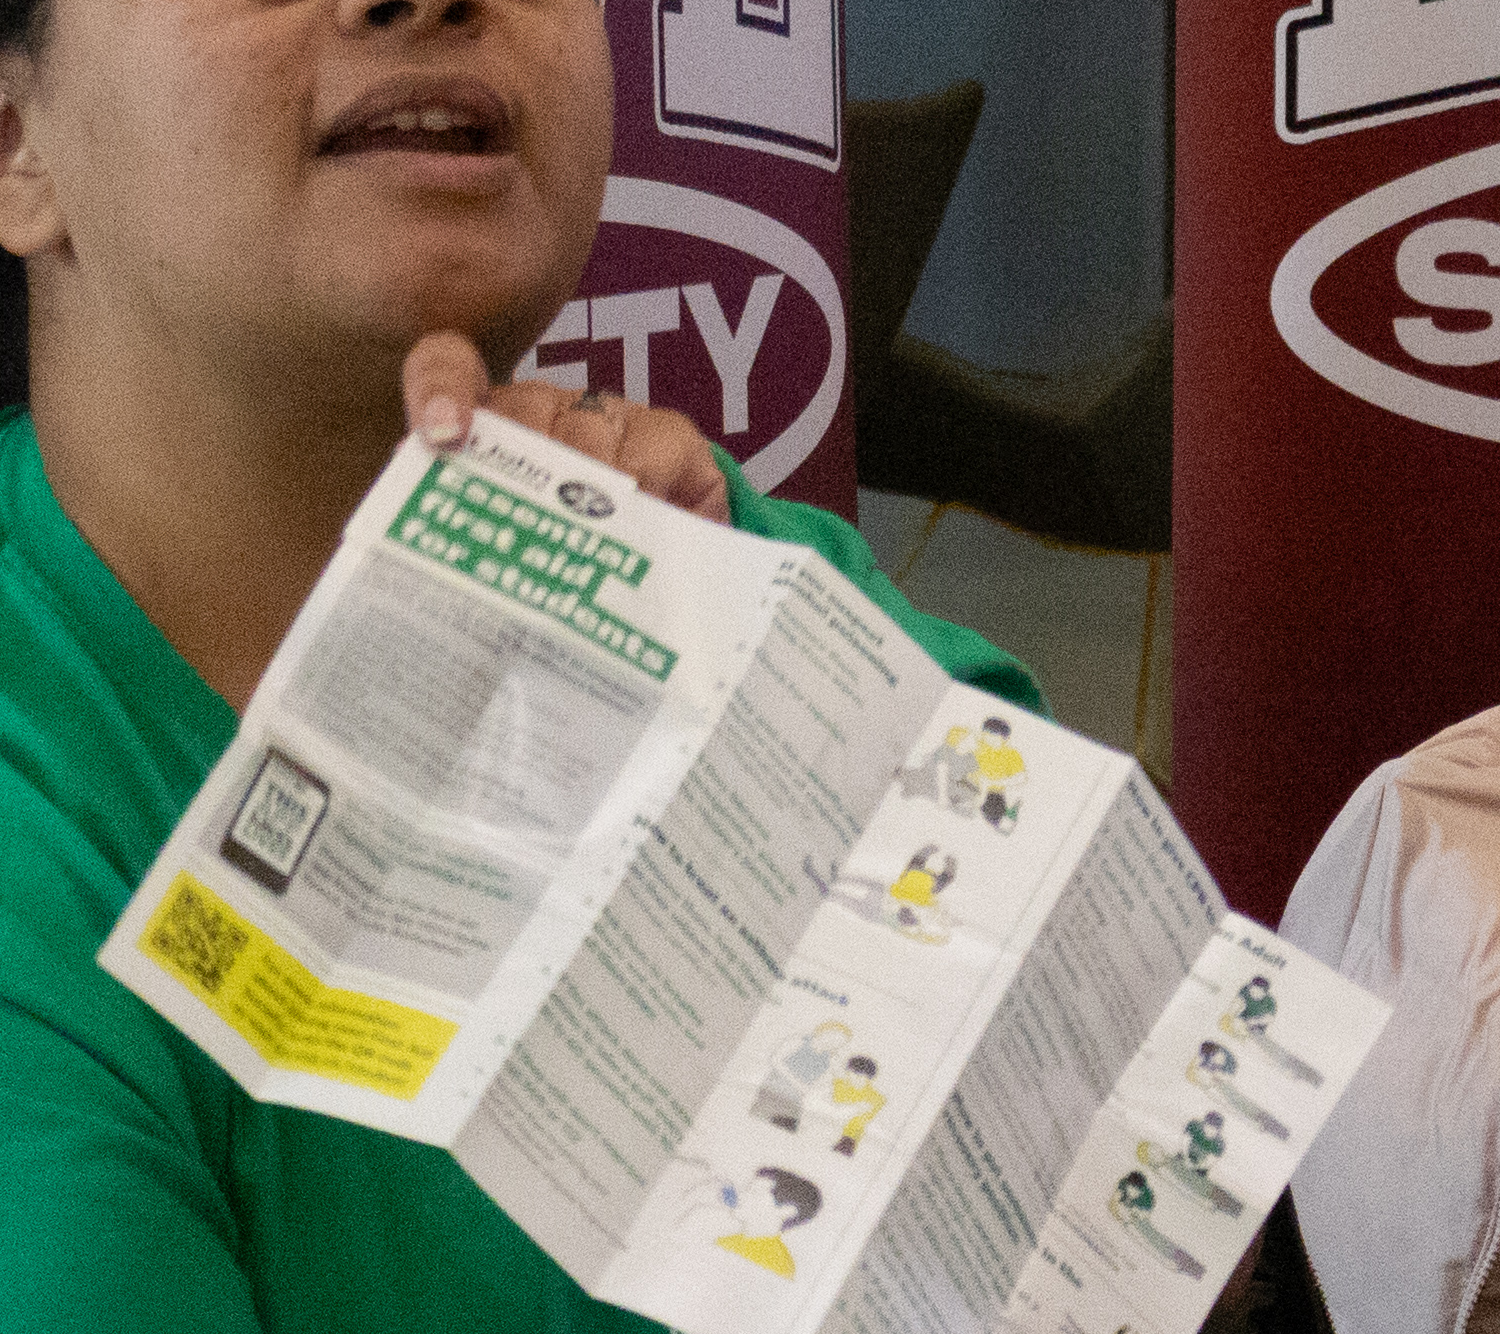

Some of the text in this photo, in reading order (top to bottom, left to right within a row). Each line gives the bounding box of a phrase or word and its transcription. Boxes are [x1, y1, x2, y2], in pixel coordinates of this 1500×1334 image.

[416, 486, 596, 594] first aid
[434, 463, 641, 581] Essential
[398, 514, 670, 676] for students
